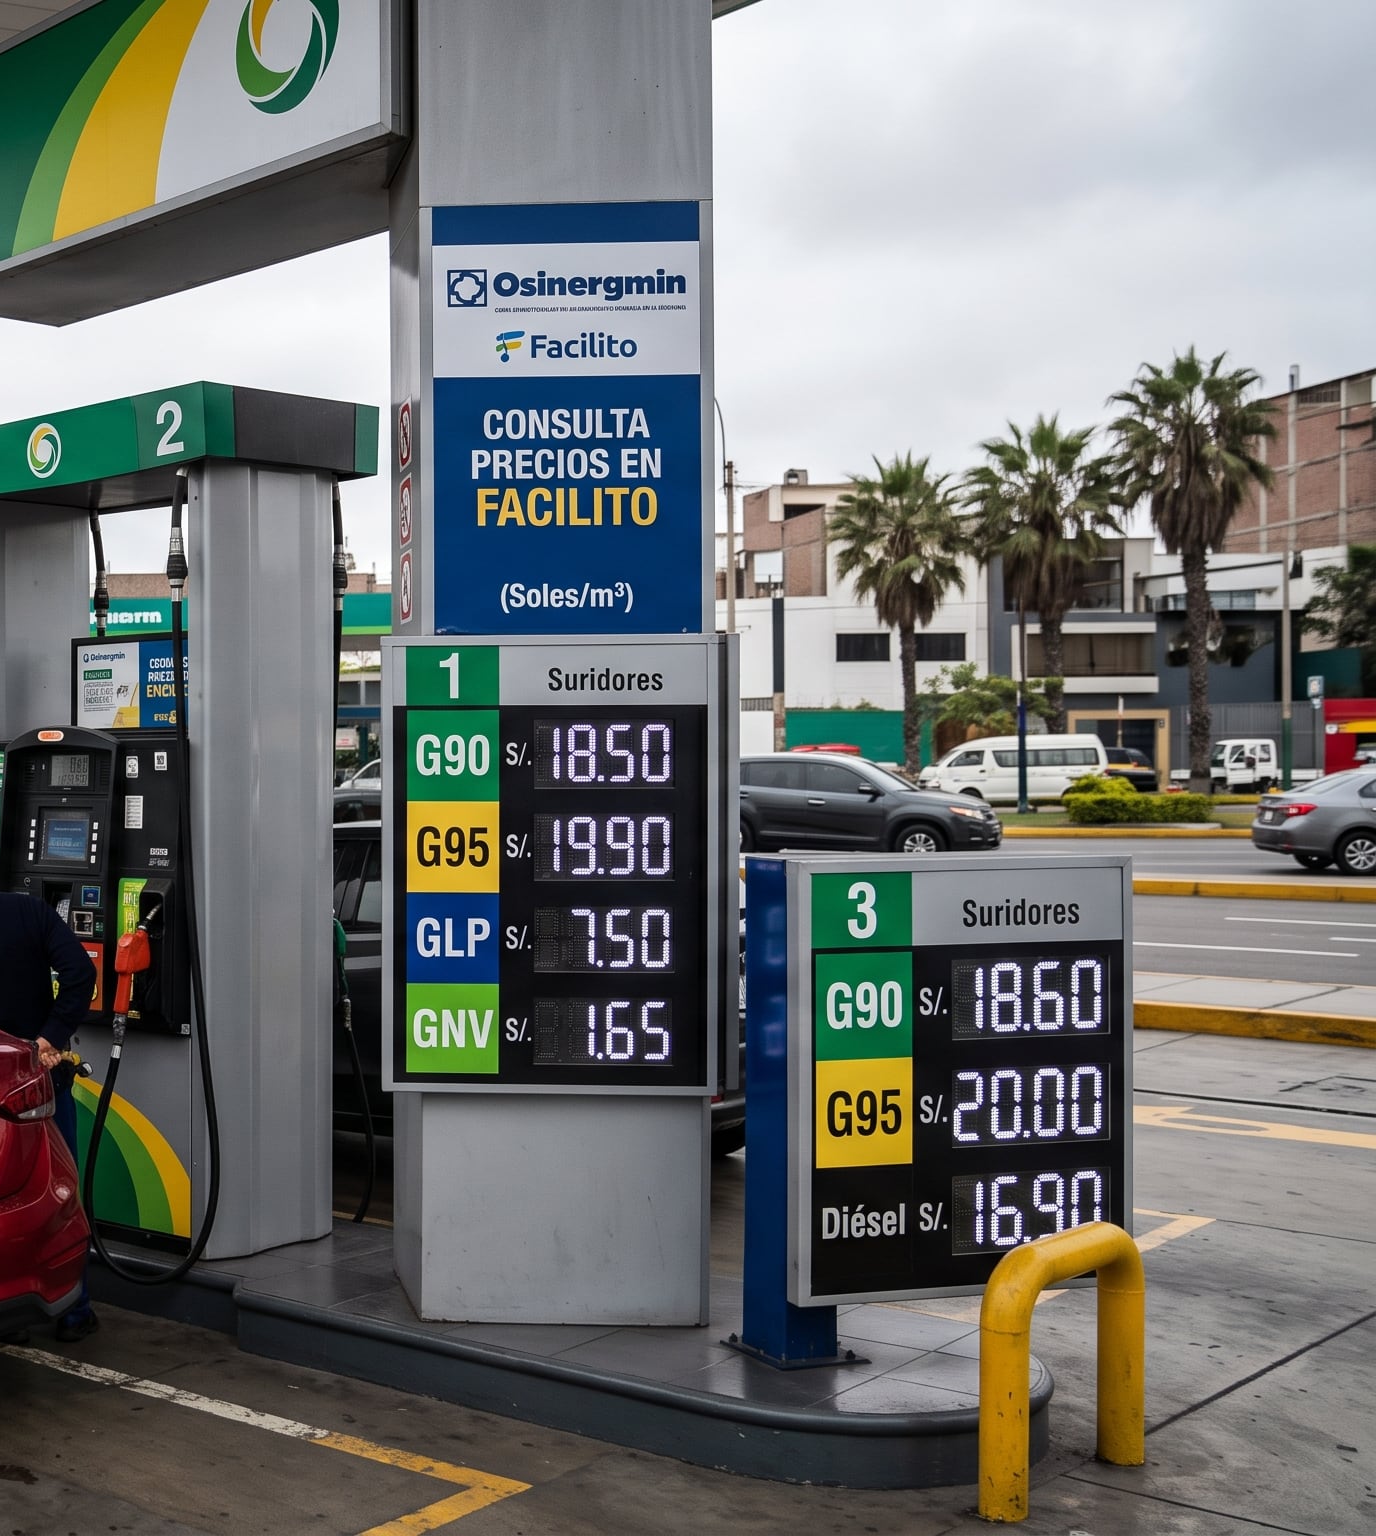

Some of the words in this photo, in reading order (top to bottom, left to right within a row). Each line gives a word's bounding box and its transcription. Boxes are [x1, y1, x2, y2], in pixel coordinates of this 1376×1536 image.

[493, 268, 686, 301] Osinergmin
[530, 331, 638, 360] Facilito
[156, 400, 185, 457] 2
[482, 407, 650, 440] CONSULTA
[471, 449, 610, 480] PRECIOS
[620, 447, 662, 479] EN
[476, 486, 659, 528] FACILITO
[438, 652, 460, 700] 1
[547, 667, 664, 693] Suridores
[415, 733, 490, 776] G90
[505, 742, 532, 767] S/.
[552, 723, 671, 783] 18.50
[415, 826, 490, 868] G95
[505, 834, 532, 859] S/.
[552, 816, 671, 875] 19.90
[415, 917, 491, 958] GLP
[505, 925, 532, 951] S/.
[570, 908, 671, 969] 7.50
[846, 880, 878, 939] 3
[962, 897, 1080, 929] Suridores
[826, 980, 903, 1030] G90
[918, 986, 948, 1016] S/.
[973, 958, 1103, 1034] 18.60
[412, 1008, 494, 1049] GNV
[505, 1017, 532, 1043] S/.
[587, 1000, 670, 1061] 1.65
[826, 1089, 903, 1137] G95
[918, 1095, 948, 1124] S/.
[952, 1065, 1103, 1142] 20.00
[821, 1202, 906, 1241] Diésel
[918, 1202, 948, 1231] S/.
[974, 1169, 1103, 1247] 16.90
